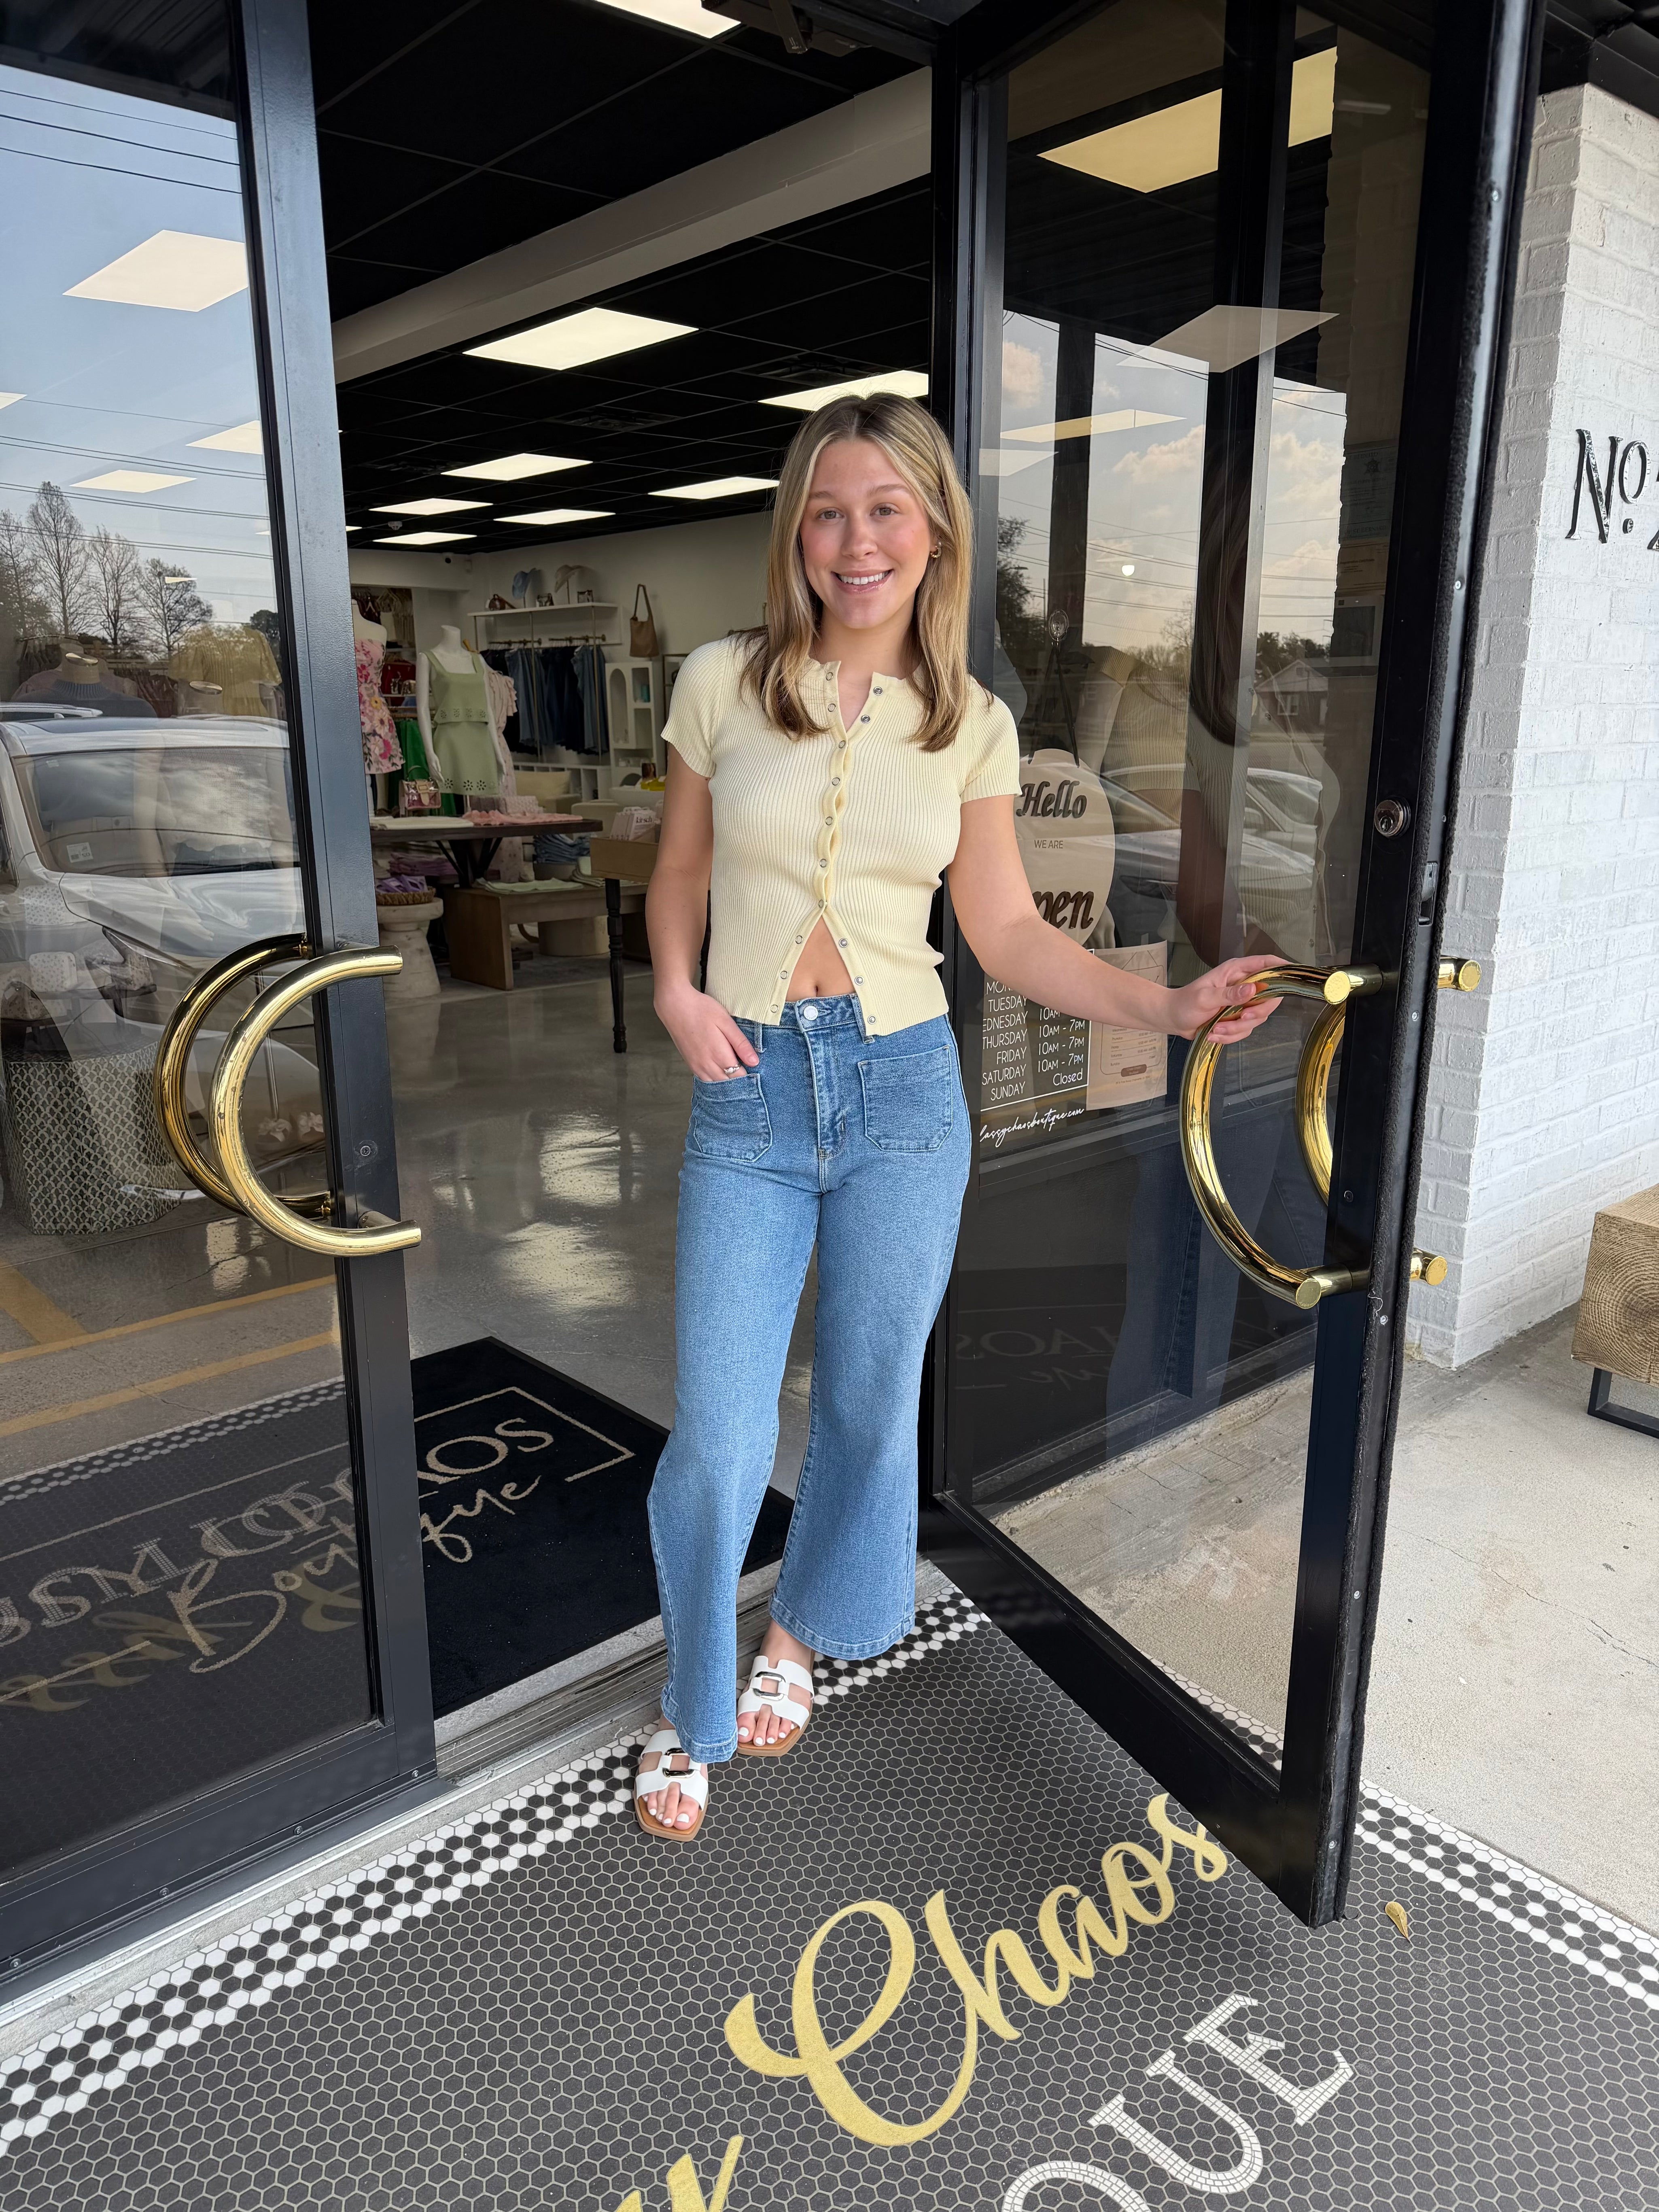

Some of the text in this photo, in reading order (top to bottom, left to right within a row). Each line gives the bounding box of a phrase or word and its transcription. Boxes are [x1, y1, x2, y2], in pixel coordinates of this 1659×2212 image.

[1016, 780, 1087, 818] Hello
[1034, 839, 1063, 849] WE ARE
[989, 995, 1027, 1012] TUESDAY
[982, 1011, 1028, 1032] EDNESDAY
[982, 1029, 1027, 1049] THURSDAY
[1040, 1024, 1059, 1038] 10AM
[1069, 1019, 1085, 1032] 7PM
[997, 1046, 1027, 1064] FRIDAY
[1039, 1042, 1059, 1055] 10AM
[1069, 1036, 1084, 1049] 7PM
[982, 1064, 1027, 1085] SATURDAY
[1038, 1059, 1058, 1072] 10AM
[1068, 1053, 1084, 1066] 7PM
[991, 1068, 1083, 1101] SUNDAY Closed
[724, 1793, 1228, 2147] Chaos
